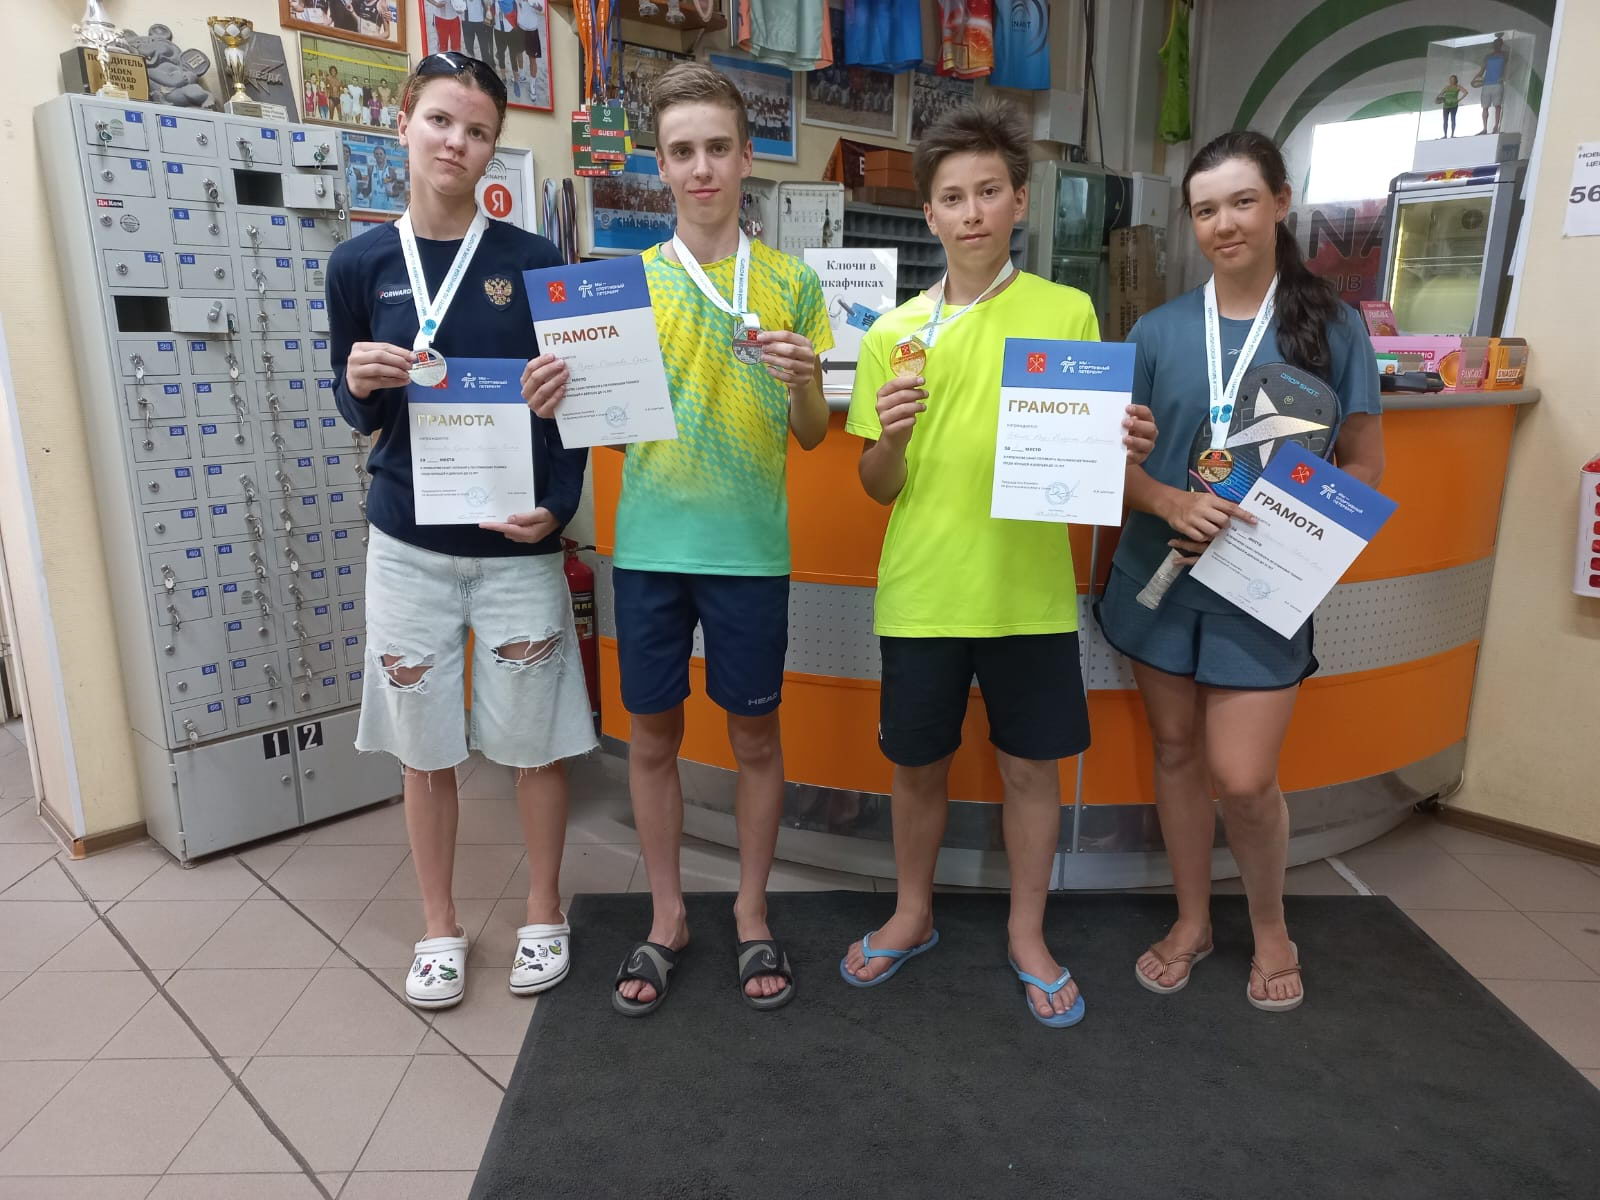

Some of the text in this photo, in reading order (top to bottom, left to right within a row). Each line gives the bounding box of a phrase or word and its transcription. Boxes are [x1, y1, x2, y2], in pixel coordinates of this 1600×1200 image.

[87, 53, 143, 68] ПОДИТЕЛЬ
[491, 190, 504, 212] Я
[826, 260, 877, 271] Ключи в
[379, 288, 412, 299] FORWARD
[543, 325, 620, 346] ГРАМОТА
[1008, 400, 1090, 416] ГРАМОТА
[416, 414, 495, 427] ГРАМОТА
[1254, 491, 1325, 541] ГРАМОТА
[273, 732, 280, 757] 1
[303, 724, 317, 750] 2
